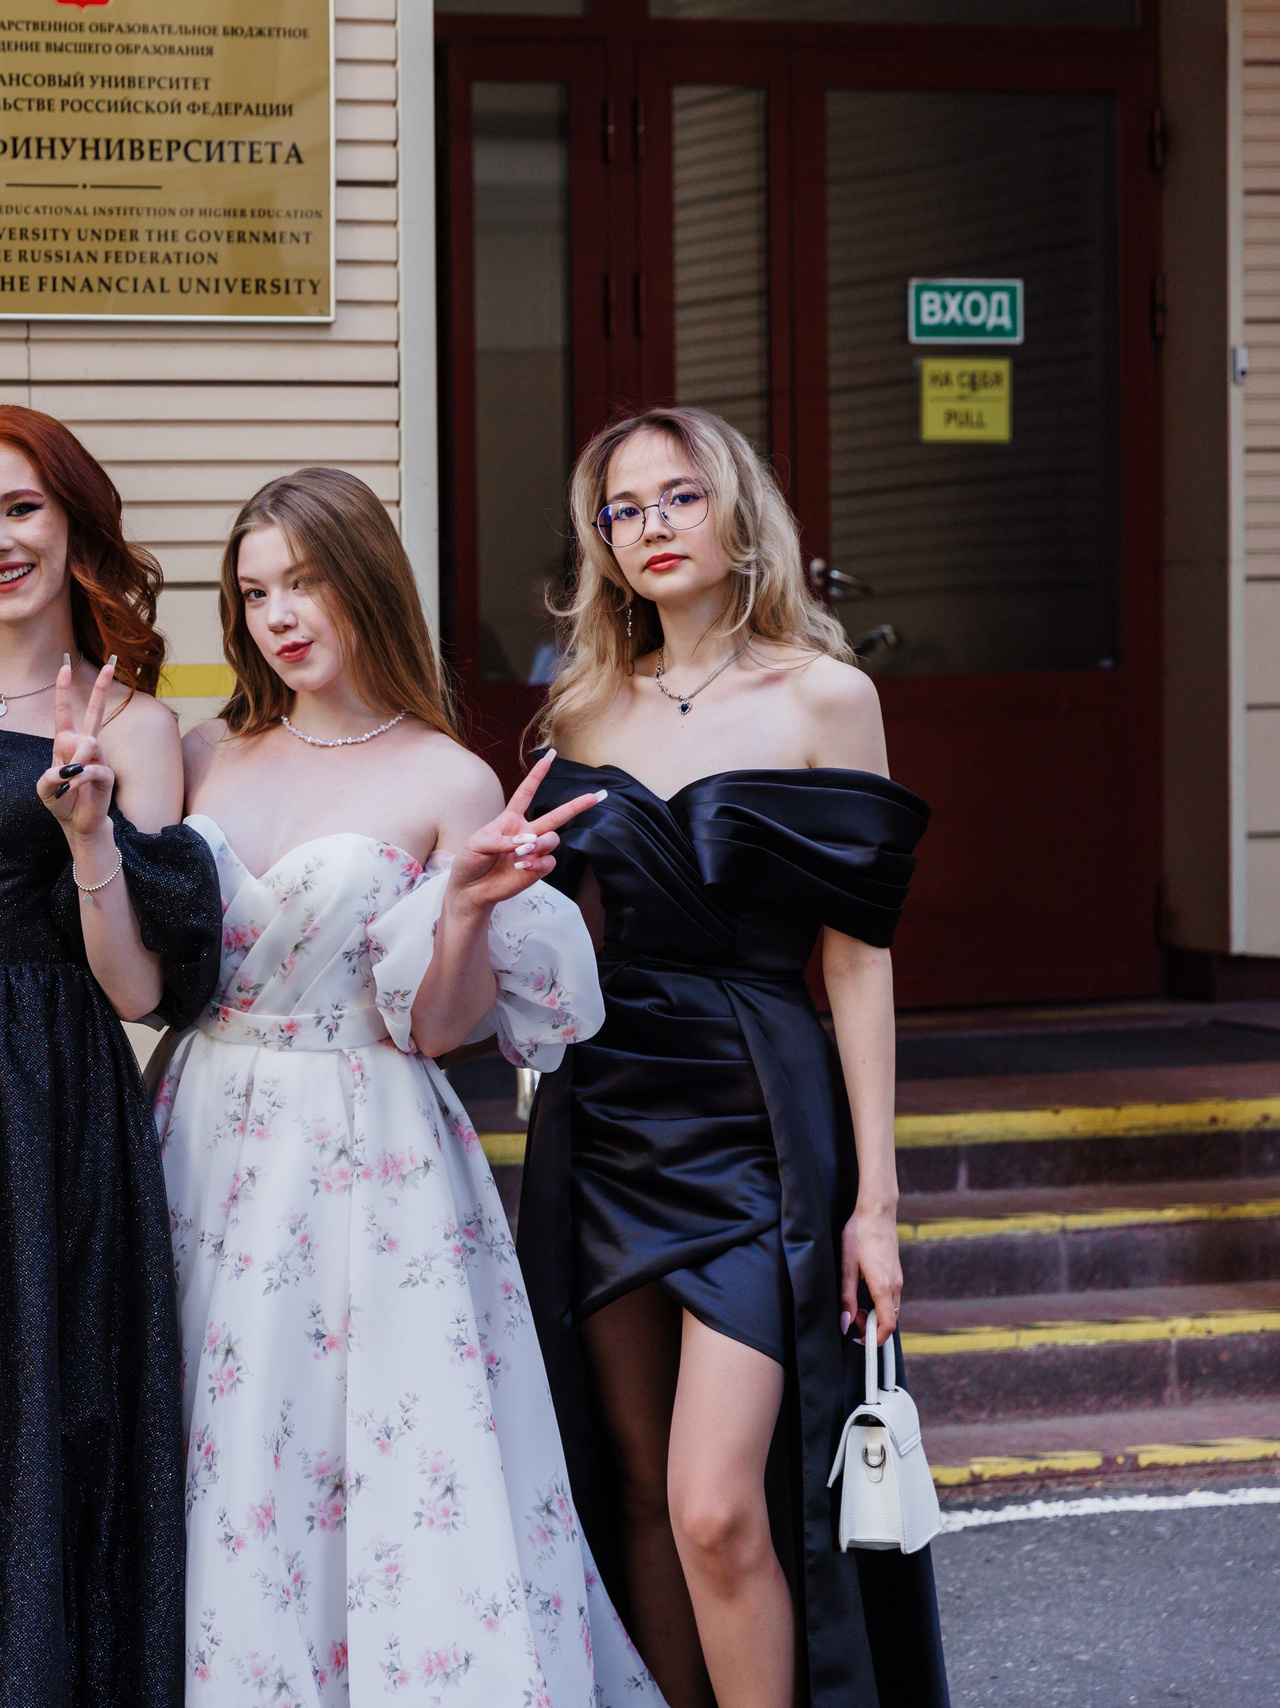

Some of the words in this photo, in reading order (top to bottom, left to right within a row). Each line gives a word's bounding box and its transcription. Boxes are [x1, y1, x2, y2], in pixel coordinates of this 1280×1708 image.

[88, 22, 218, 37] ОБРАЗОВАТЕЛЬНОЕ
[223, 26, 310, 39] БЮДЖЕТНОЕ
[45, 42, 112, 55] ВЫСШЕГО
[115, 43, 214, 56] ОБРАЗОВАНИЯ
[89, 74, 211, 91] УНИВЕРСИТЕТ
[60, 96, 182, 116] РОССИЙСКОЙ
[186, 101, 294, 118] ФЕДЕРАЦИИ
[93, 206, 175, 217] INSTITUTION
[180, 208, 196, 218] OF
[199, 208, 247, 219] HIGHER
[251, 209, 322, 219] EDUCATION
[77, 228, 140, 243] UNDER
[145, 229, 180, 243] THE
[185, 230, 313, 245] GOVERNMENT
[18, 249, 99, 264] RUSSIAN
[104, 251, 220, 265] FEDERATION
[38, 276, 170, 294] FINANCIAL
[178, 278, 321, 296] UNIVERSITY
[920, 290, 1013, 332] ВХОД
